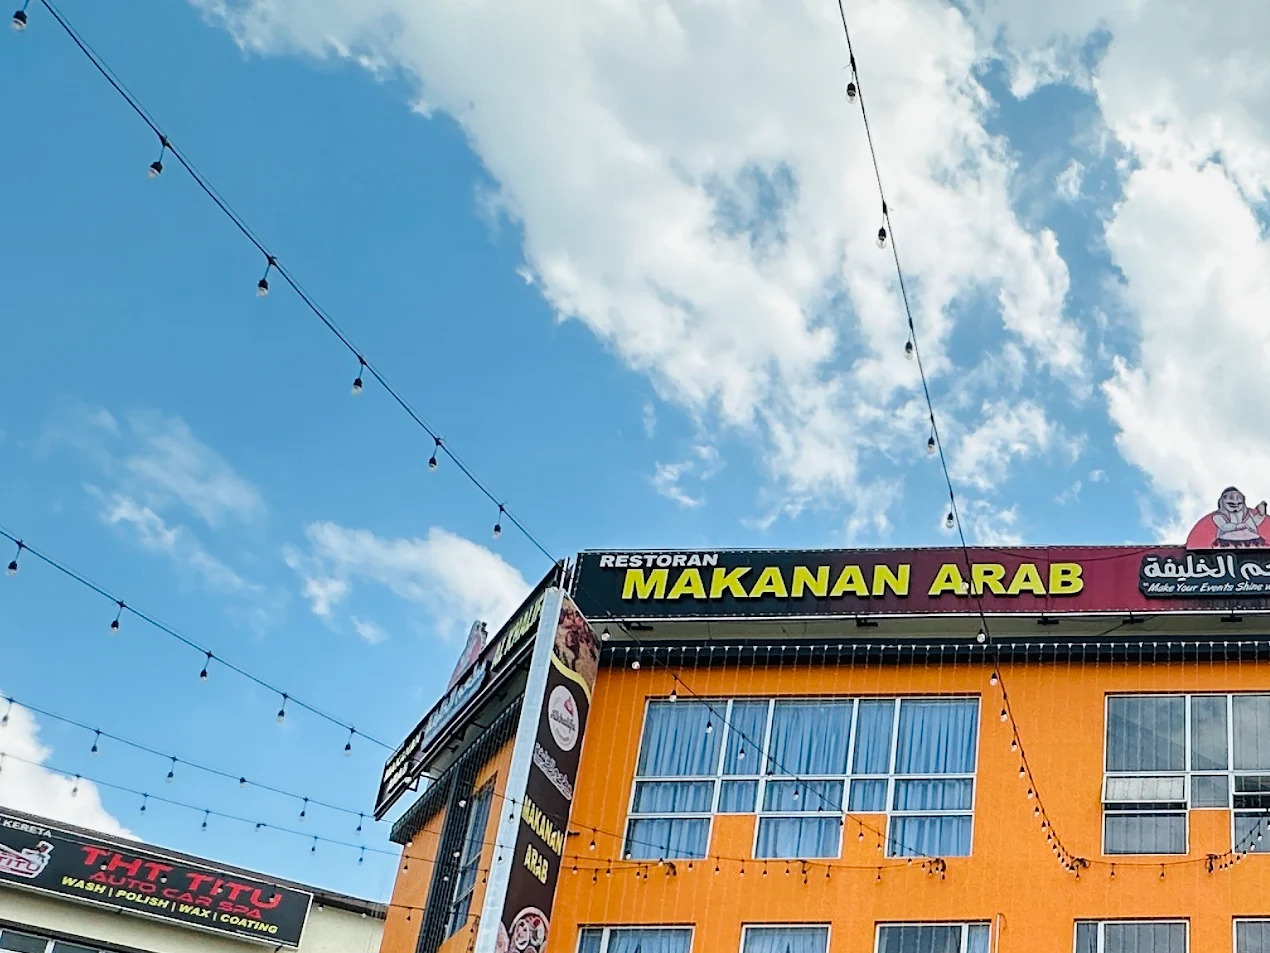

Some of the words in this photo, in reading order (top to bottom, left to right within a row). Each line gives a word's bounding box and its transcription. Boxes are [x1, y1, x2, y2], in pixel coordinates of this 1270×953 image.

[599, 552, 720, 569] RESTORAN
[1144, 555, 1236, 582] الخليفة
[621, 562, 911, 601] MAKANAN
[928, 562, 1085, 597] ARAB
[1176, 582, 1198, 592] Your
[1200, 582, 1233, 592] Events
[1235, 581, 1262, 592] Shine
[3, 820, 52, 839] KERETA
[522, 795, 565, 857] MAKANAN
[82, 844, 173, 881] THT
[186, 872, 282, 909] TITU
[523, 843, 550, 885] ARAB
[61, 876, 107, 894] WASH
[115, 889, 170, 909] POLISH
[179, 904, 212, 919] WAX
[220, 914, 278, 934] COATING
[89, 871, 156, 894] AUTO
[162, 888, 213, 906] CAR
[216, 901, 262, 919] SPA
